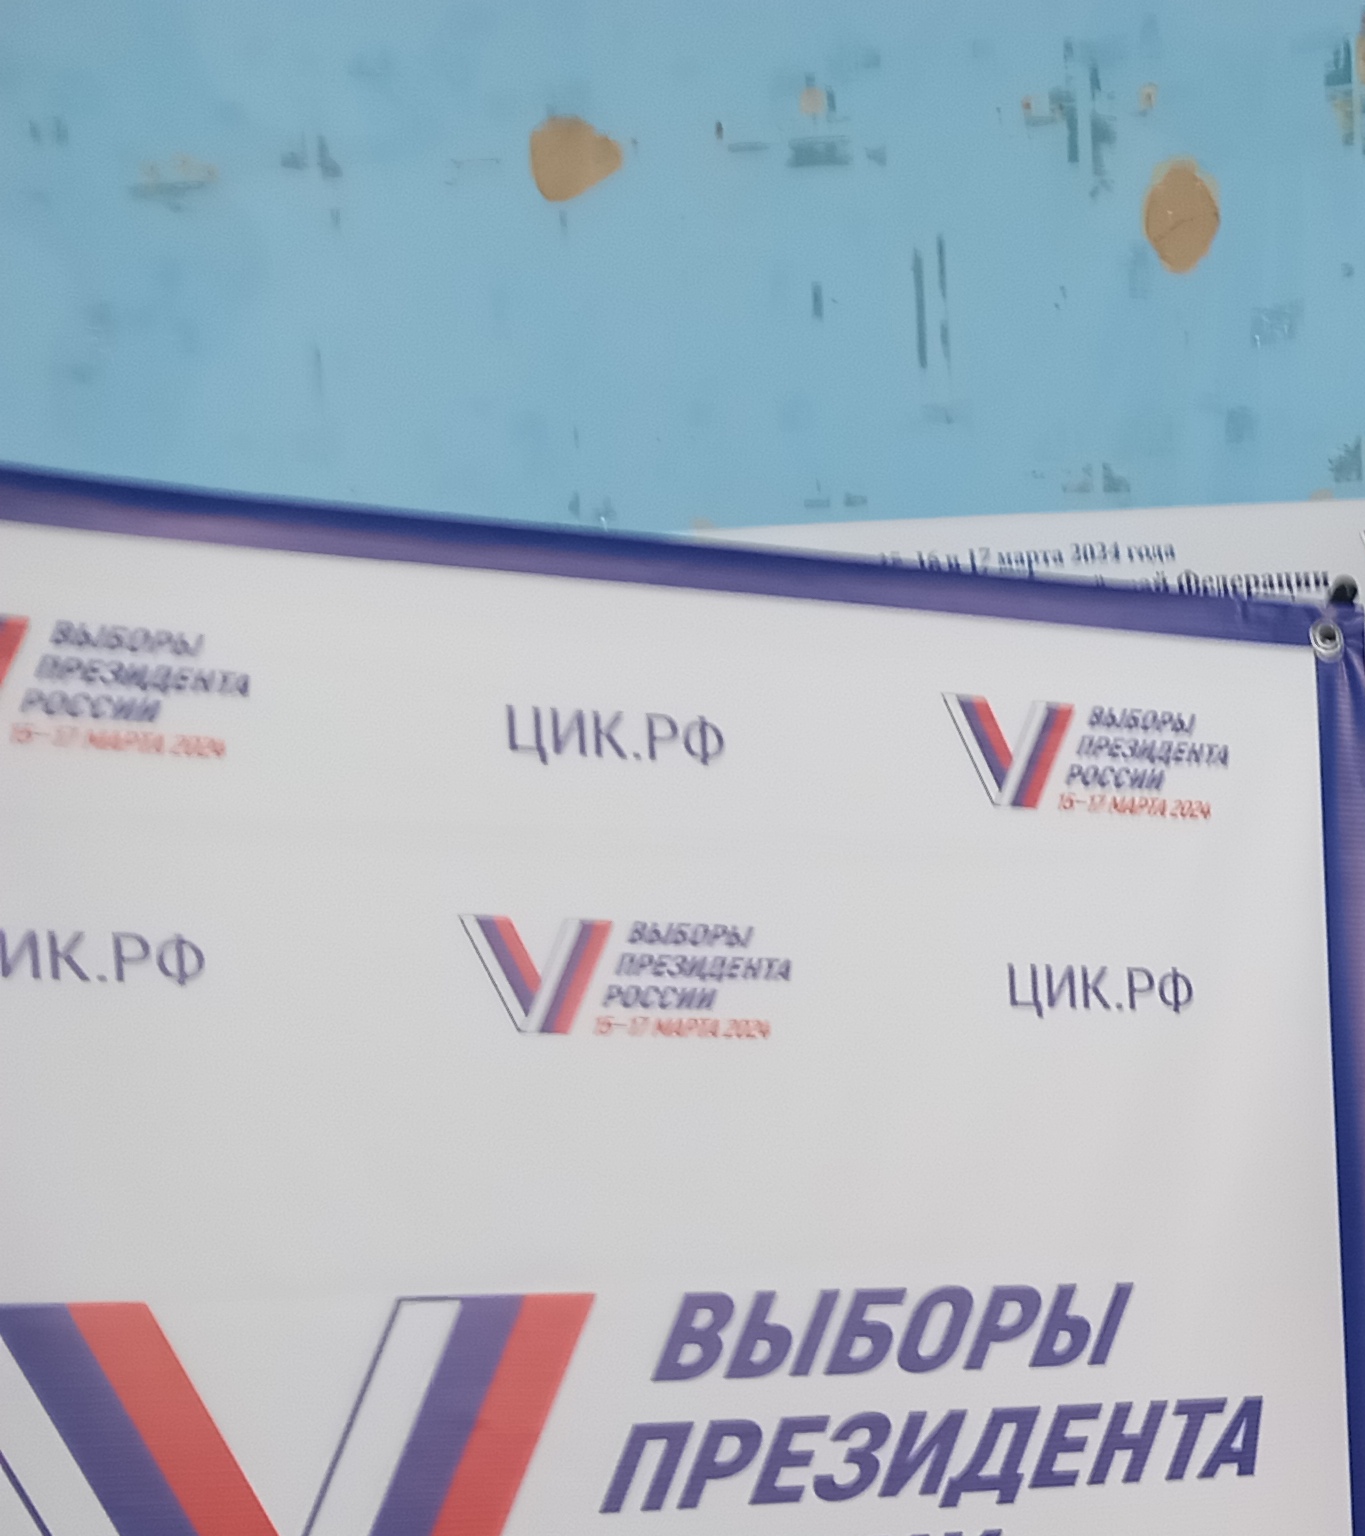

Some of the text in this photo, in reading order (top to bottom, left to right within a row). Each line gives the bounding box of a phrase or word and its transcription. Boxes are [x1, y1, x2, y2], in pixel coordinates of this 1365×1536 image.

[1127, 543, 1176, 564] года
[50, 619, 205, 657] ВЫБОРЫ
[34, 654, 250, 697] ПРЕЗИДЕНТА
[19, 688, 161, 722] РОССИИ
[1088, 705, 1196, 735] ВЫБОРЫ
[505, 702, 725, 767] ЦИК.РФ
[1076, 734, 1229, 768] ПРЕЗИДЕНТА
[1066, 764, 1166, 790] РОССИИ
[626, 920, 754, 948] ВЫБОРЫ
[614, 952, 792, 983] ПРЕЗИДЕНТА
[602, 984, 718, 1010] РОССИИ
[1007, 962, 1194, 1018] ЦИК.РФ
[651, 1281, 1133, 1383] ВЫБОРЫ
[597, 1394, 1264, 1514] ПРЕЗИДЕНТА
